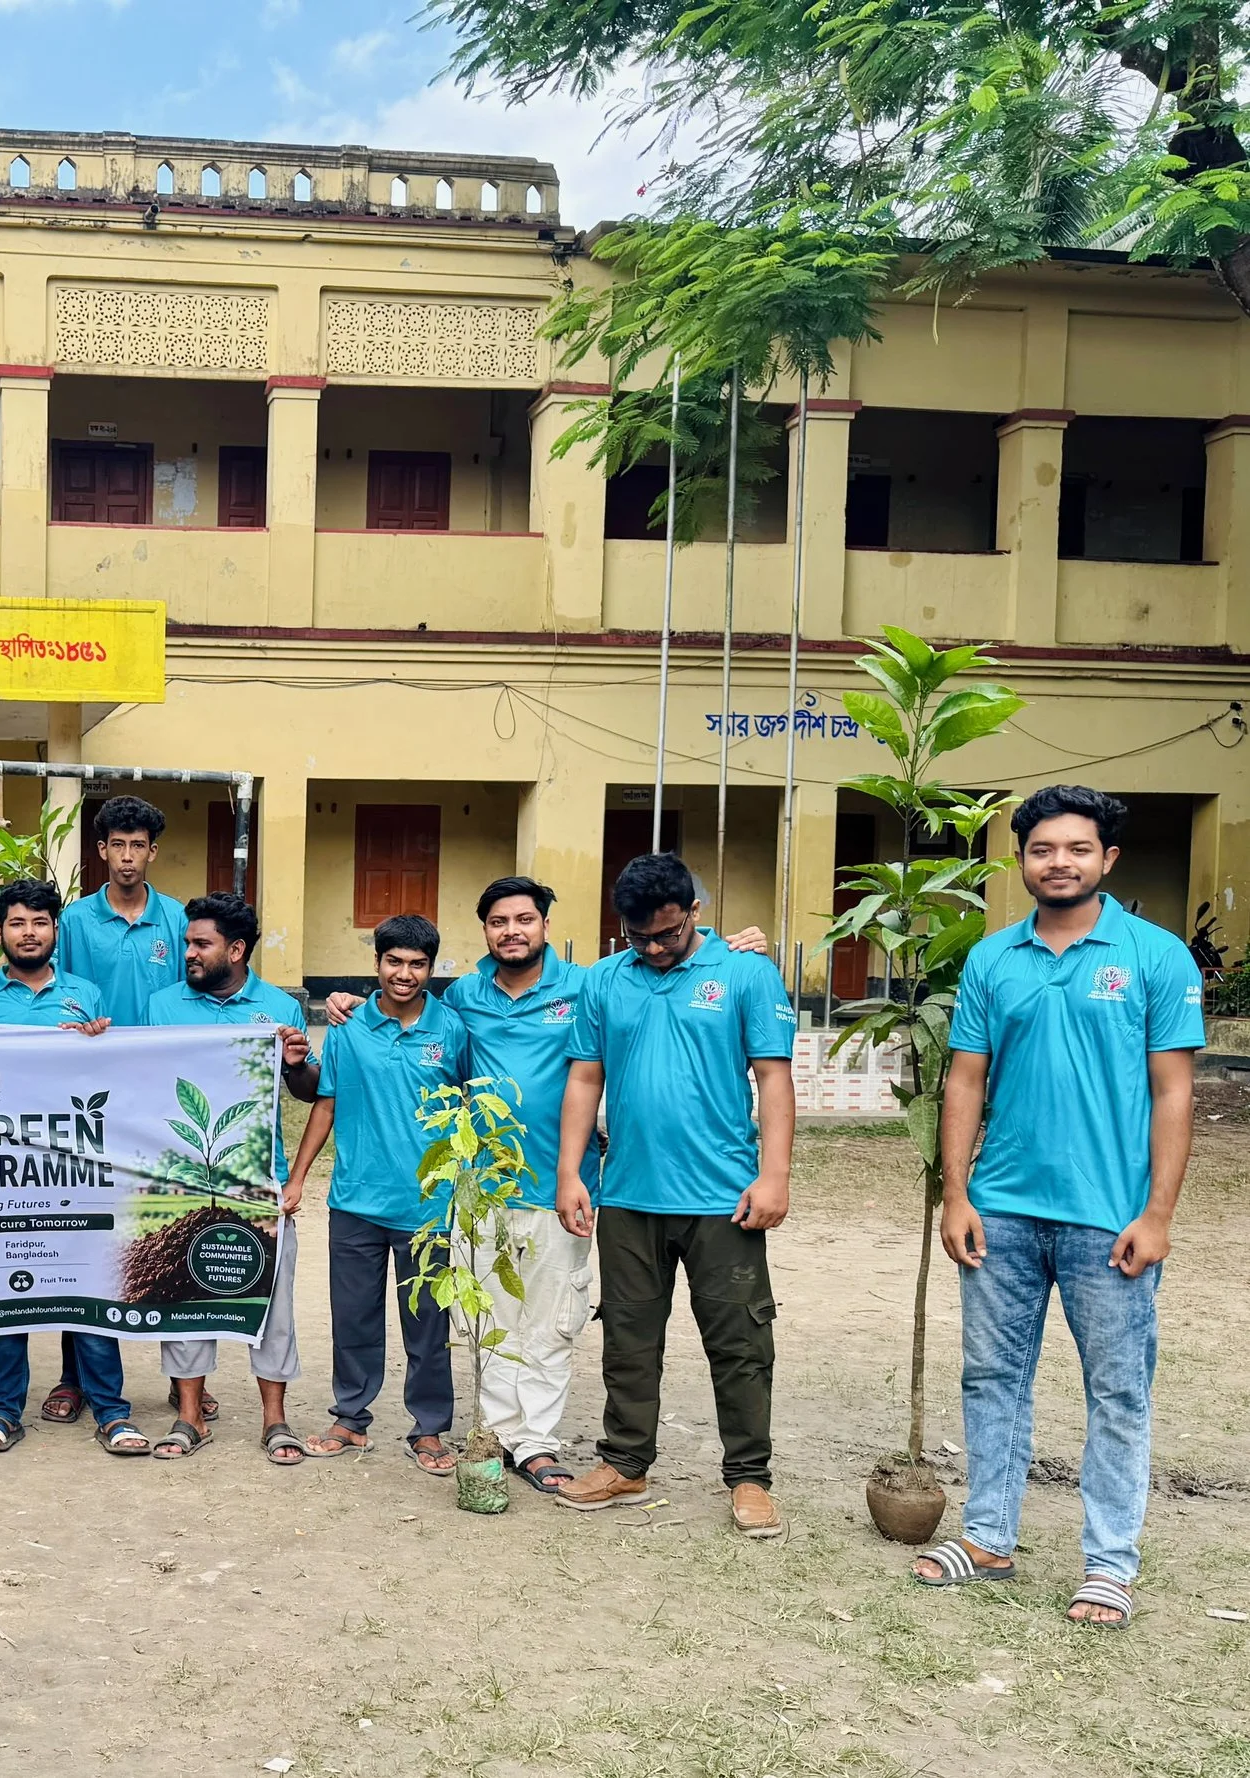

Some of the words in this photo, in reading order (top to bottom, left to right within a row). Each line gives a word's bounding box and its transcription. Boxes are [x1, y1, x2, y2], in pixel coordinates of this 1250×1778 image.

[6, 1199, 52, 1210] Futures
[29, 1217, 88, 1228] Tomorrow
[5, 1239, 46, 1250] Faridpur,
[201, 1243, 252, 1253] SUSTAINABLE
[5, 1249, 59, 1260] Bangladesh
[199, 1252, 253, 1261] COMMUNITIES
[205, 1265, 246, 1275] STRONGER
[208, 1274, 242, 1283] FUTURES
[171, 1312, 205, 1321] Melandah
[206, 1312, 246, 1322] Foundation
